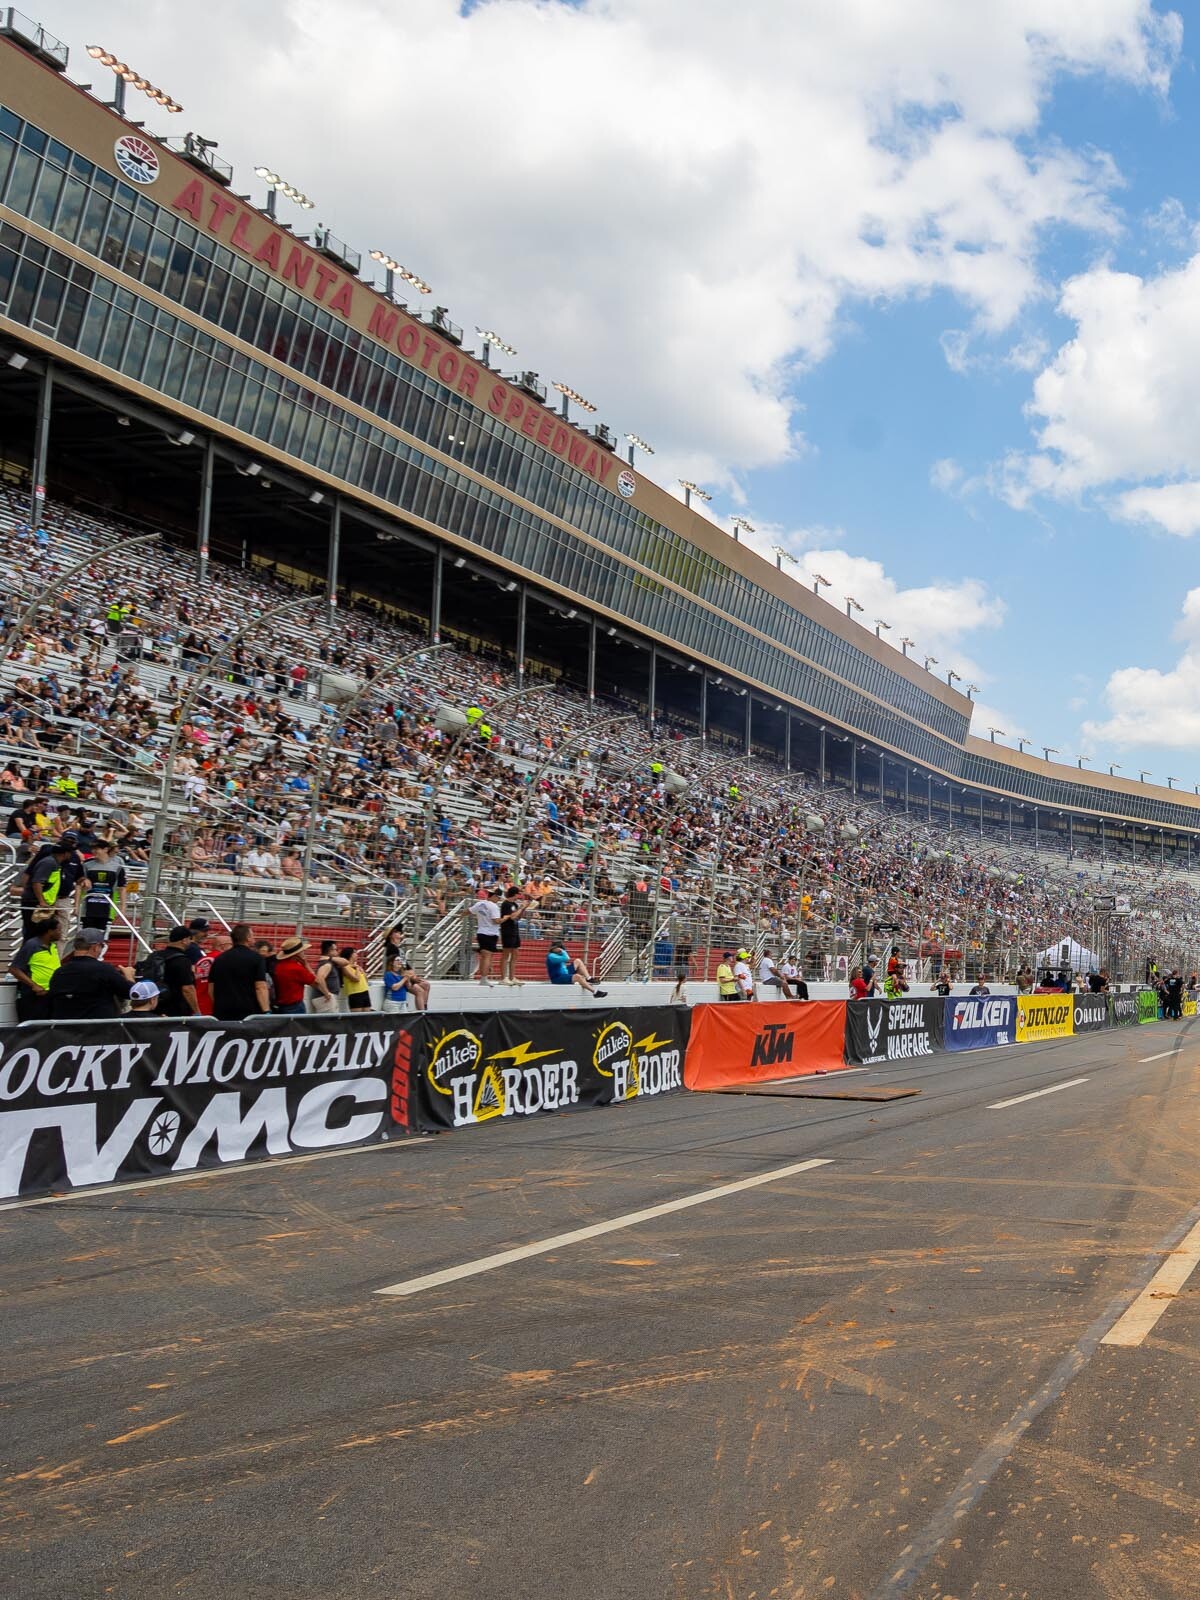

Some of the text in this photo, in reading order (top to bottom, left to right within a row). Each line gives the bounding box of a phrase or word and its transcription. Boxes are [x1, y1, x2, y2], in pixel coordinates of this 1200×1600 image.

[172, 178, 613, 482] ATLANTA MOTOR SPEEDWAY
[888, 1004, 925, 1031] SPECIAL
[952, 1001, 1010, 1030] FALKEN
[1027, 1006, 1069, 1027] DUNLOP
[434, 1042, 478, 1079] mike's
[597, 1033, 630, 1064] mike's
[751, 1024, 794, 1066] KTM
[887, 1032, 933, 1060] WARFARE
[0, 1030, 395, 1100] OCKY MOUNTAIN
[611, 1050, 682, 1103] HARDER
[450, 1060, 579, 1127] HARDER
